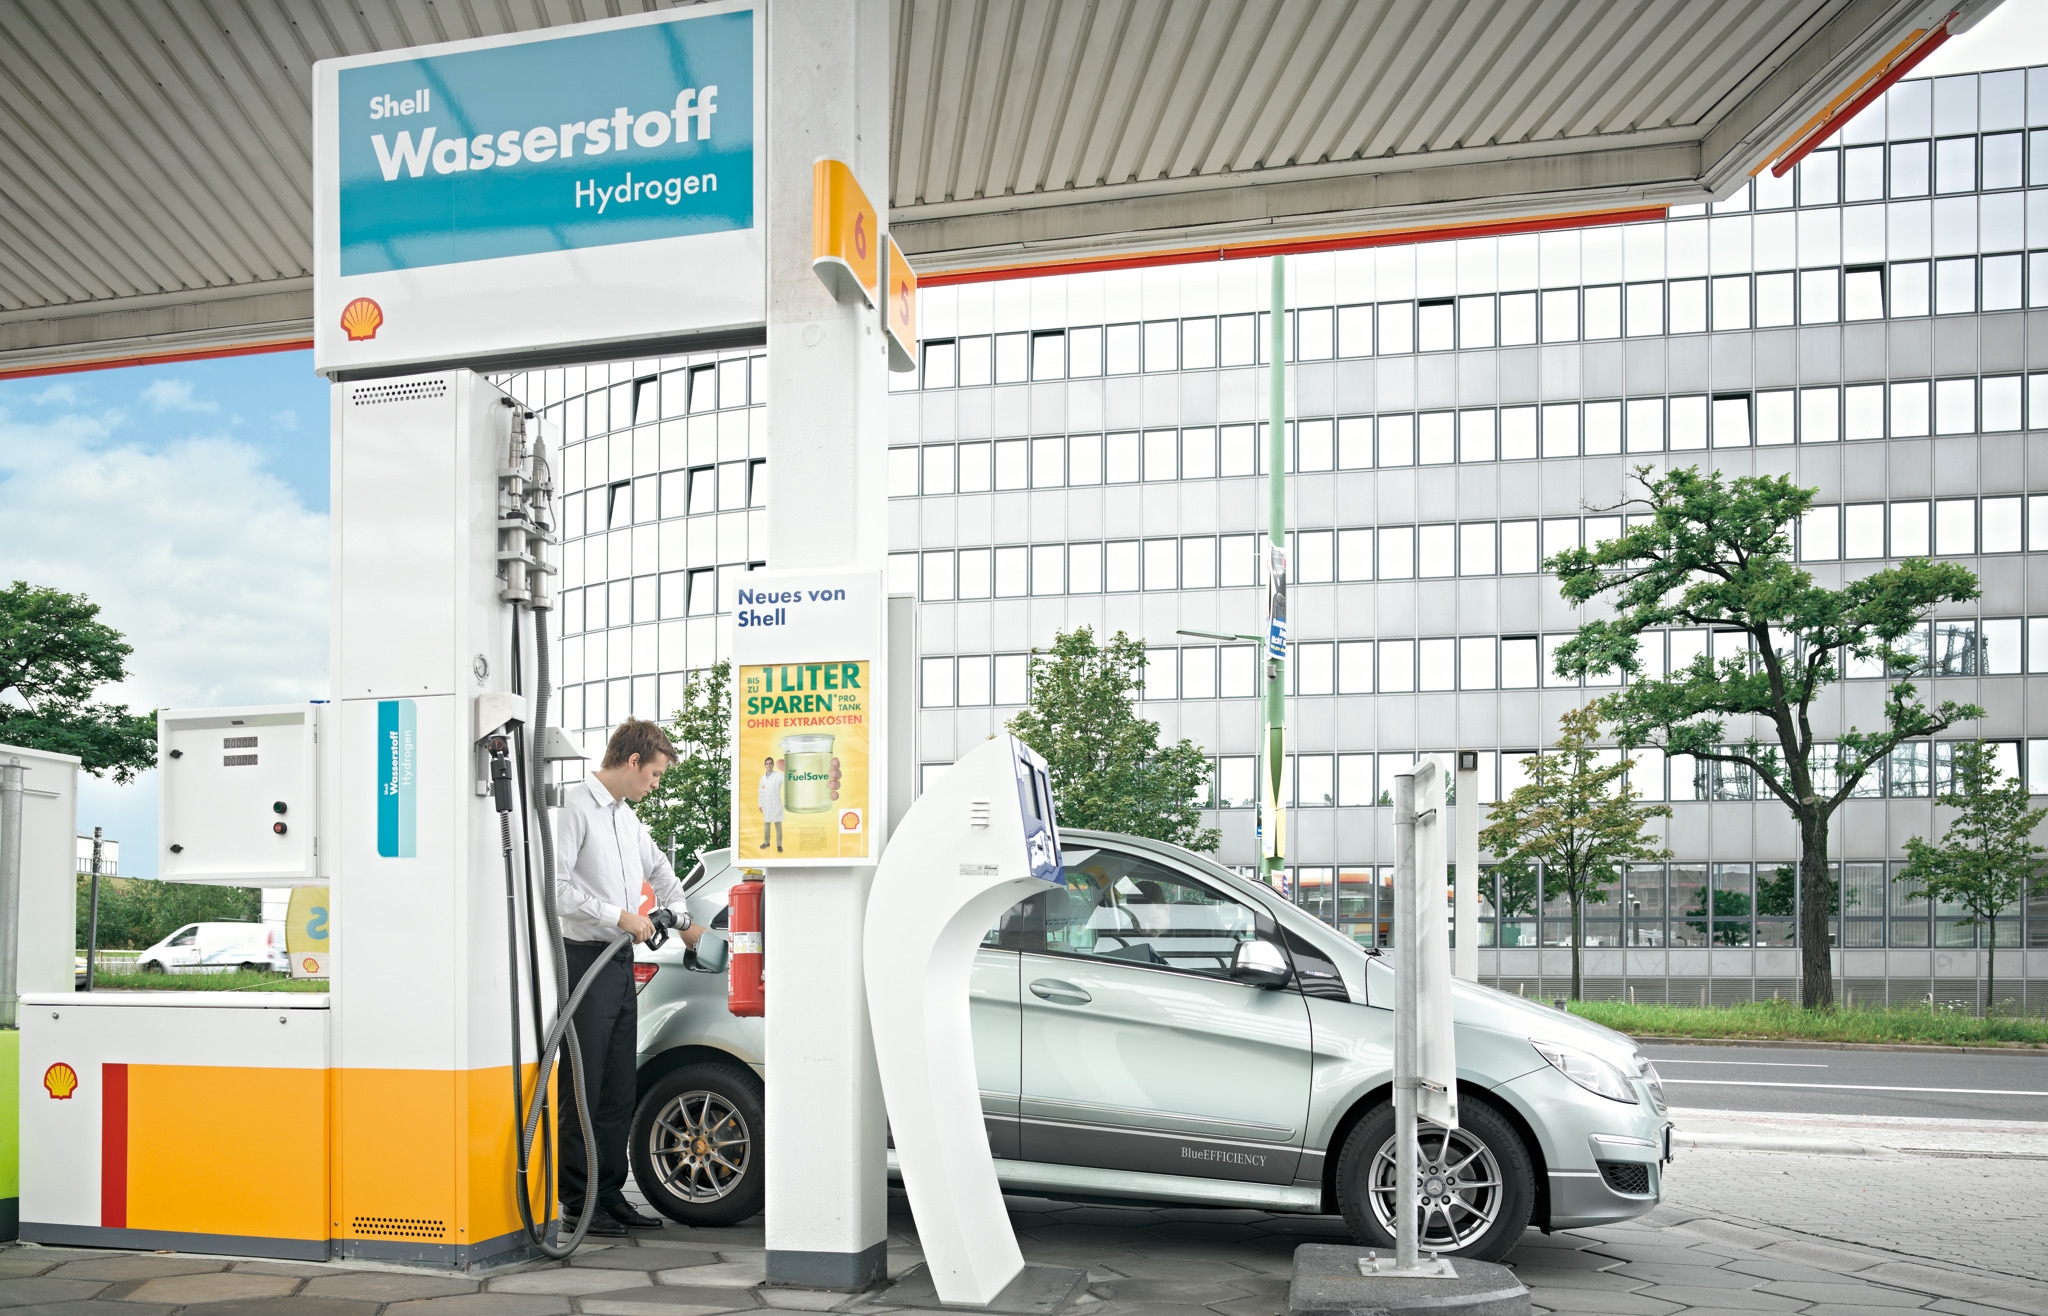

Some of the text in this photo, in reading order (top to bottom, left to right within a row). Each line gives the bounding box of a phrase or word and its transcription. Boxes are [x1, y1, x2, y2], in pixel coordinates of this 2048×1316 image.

[369, 88, 430, 120] Shell
[371, 85, 718, 182] Wasserstoff
[575, 172, 718, 214] Hydrogen
[855, 211, 866, 260] 6
[900, 280, 909, 326] 5
[738, 588, 846, 605] Neues von
[738, 608, 786, 627] Shell
[747, 677, 760, 685] BIS
[762, 663, 862, 693] 1 LITER
[747, 686, 759, 694] ZU
[838, 694, 856, 703] PRO
[838, 703, 861, 711] TANK
[747, 715, 862, 729] OHNE EXTRAKOSTEN
[390, 731, 399, 795] Wasserstoff
[402, 730, 414, 785] Hydrogen
[788, 772, 829, 781] FuelSave
[1181, 1146, 1267, 1167] BlueEFFICIENCY
